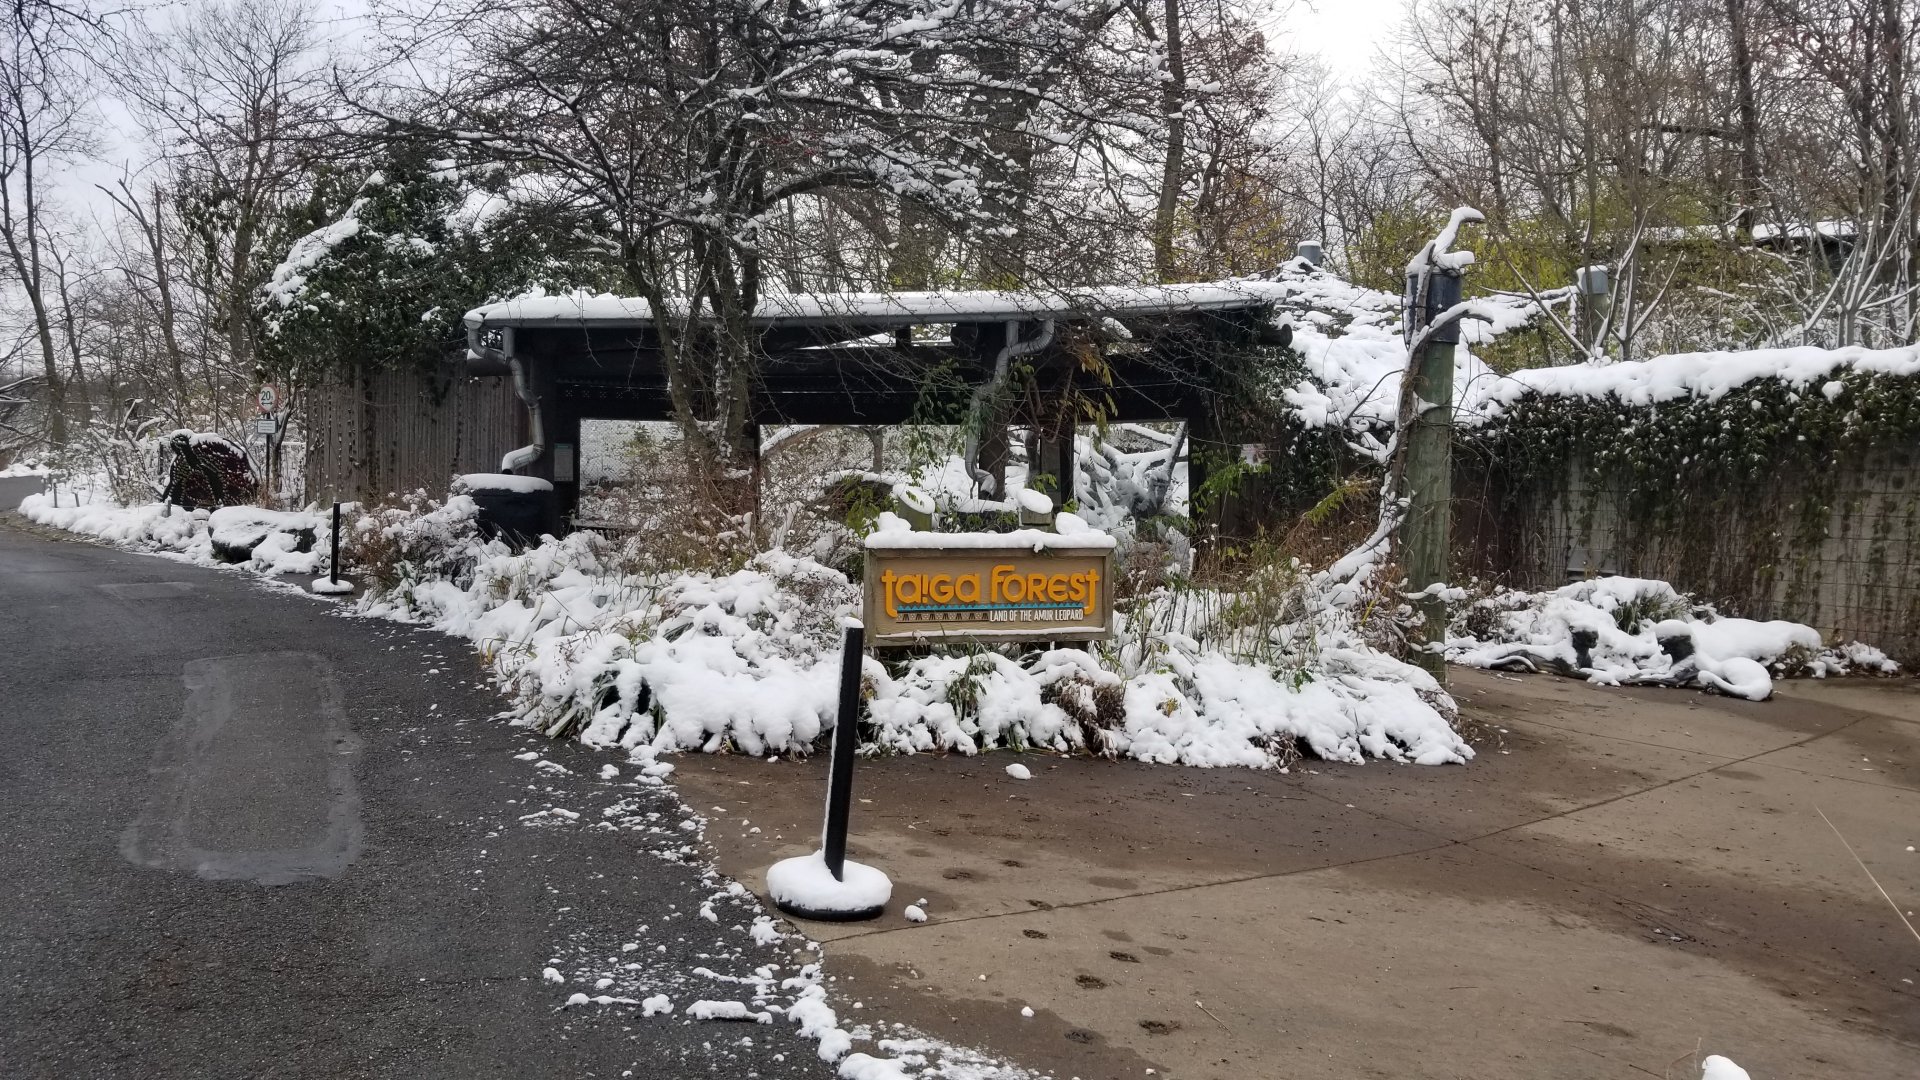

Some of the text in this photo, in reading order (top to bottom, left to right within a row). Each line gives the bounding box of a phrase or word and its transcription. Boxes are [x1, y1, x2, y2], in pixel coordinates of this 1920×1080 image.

[261, 391, 271, 401] 20
[990, 608, 1084, 622] LAND OF THE AMUR LEOPARD
